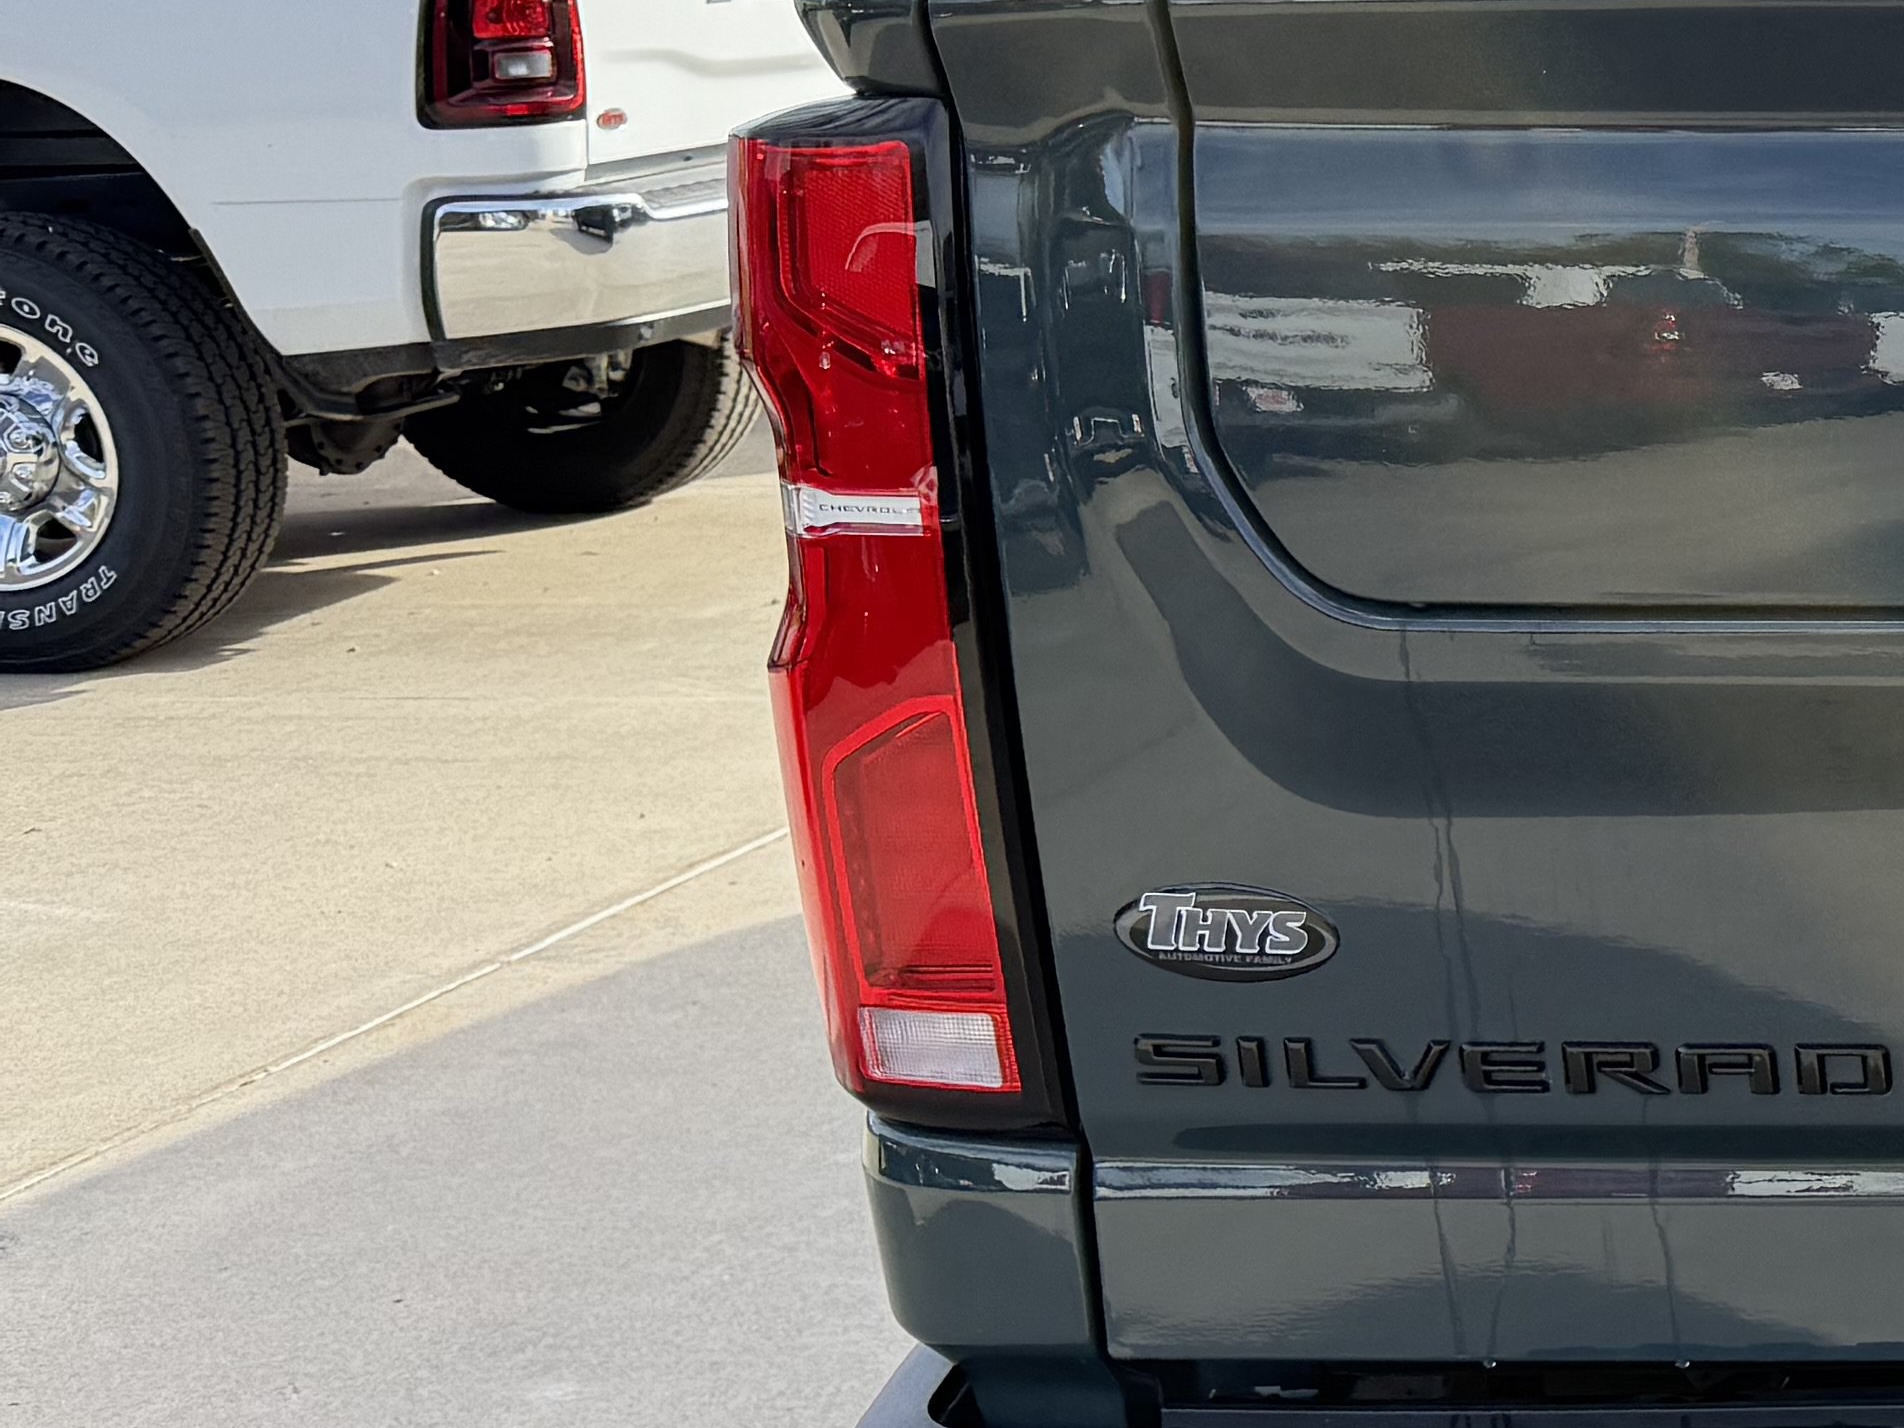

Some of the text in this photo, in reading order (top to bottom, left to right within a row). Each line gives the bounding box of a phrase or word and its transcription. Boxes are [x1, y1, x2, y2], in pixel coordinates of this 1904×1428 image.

[0, 285, 99, 367] one
[0, 565, 118, 630] TRANS
[1138, 892, 1309, 955] THYS
